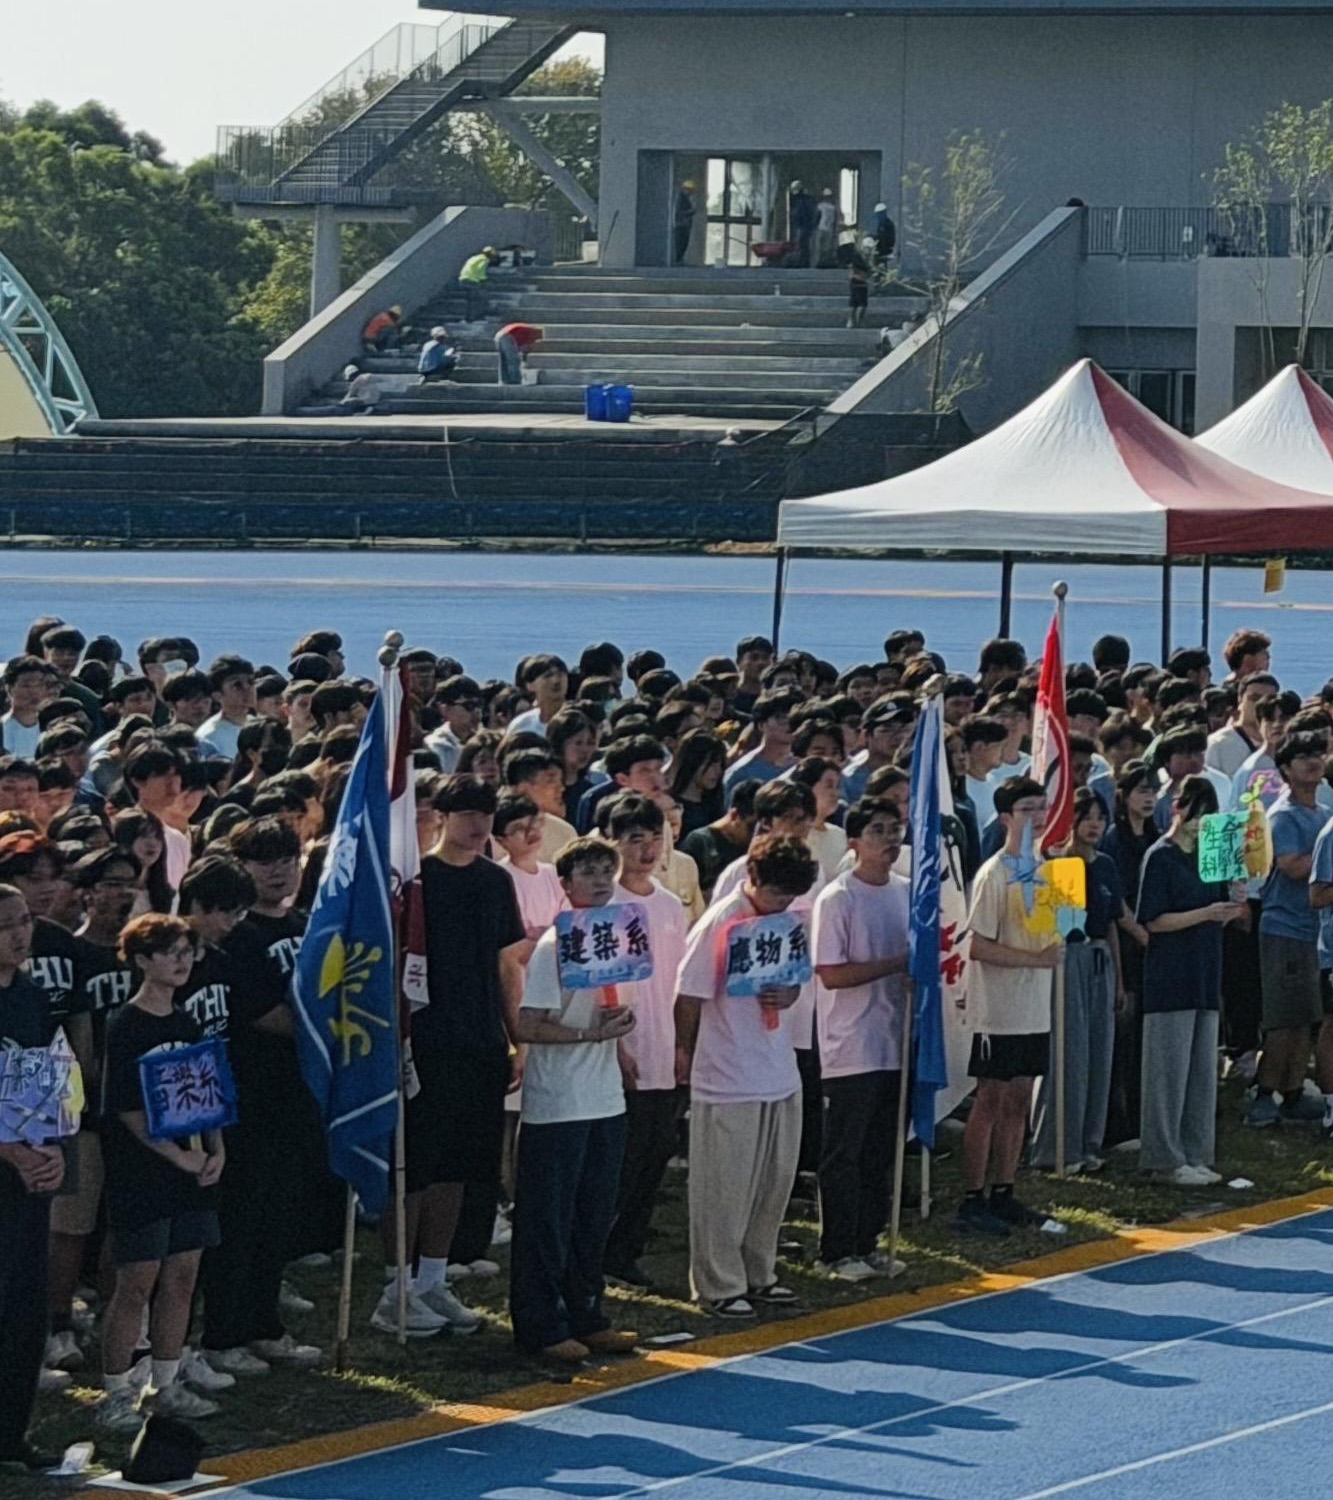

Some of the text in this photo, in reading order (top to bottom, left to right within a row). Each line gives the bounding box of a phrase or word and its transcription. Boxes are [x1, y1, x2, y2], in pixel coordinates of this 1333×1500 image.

[268, 936, 303, 974] TH
[560, 916, 650, 965] 建築系
[28, 955, 73, 990] HU
[86, 970, 132, 1009] TH
